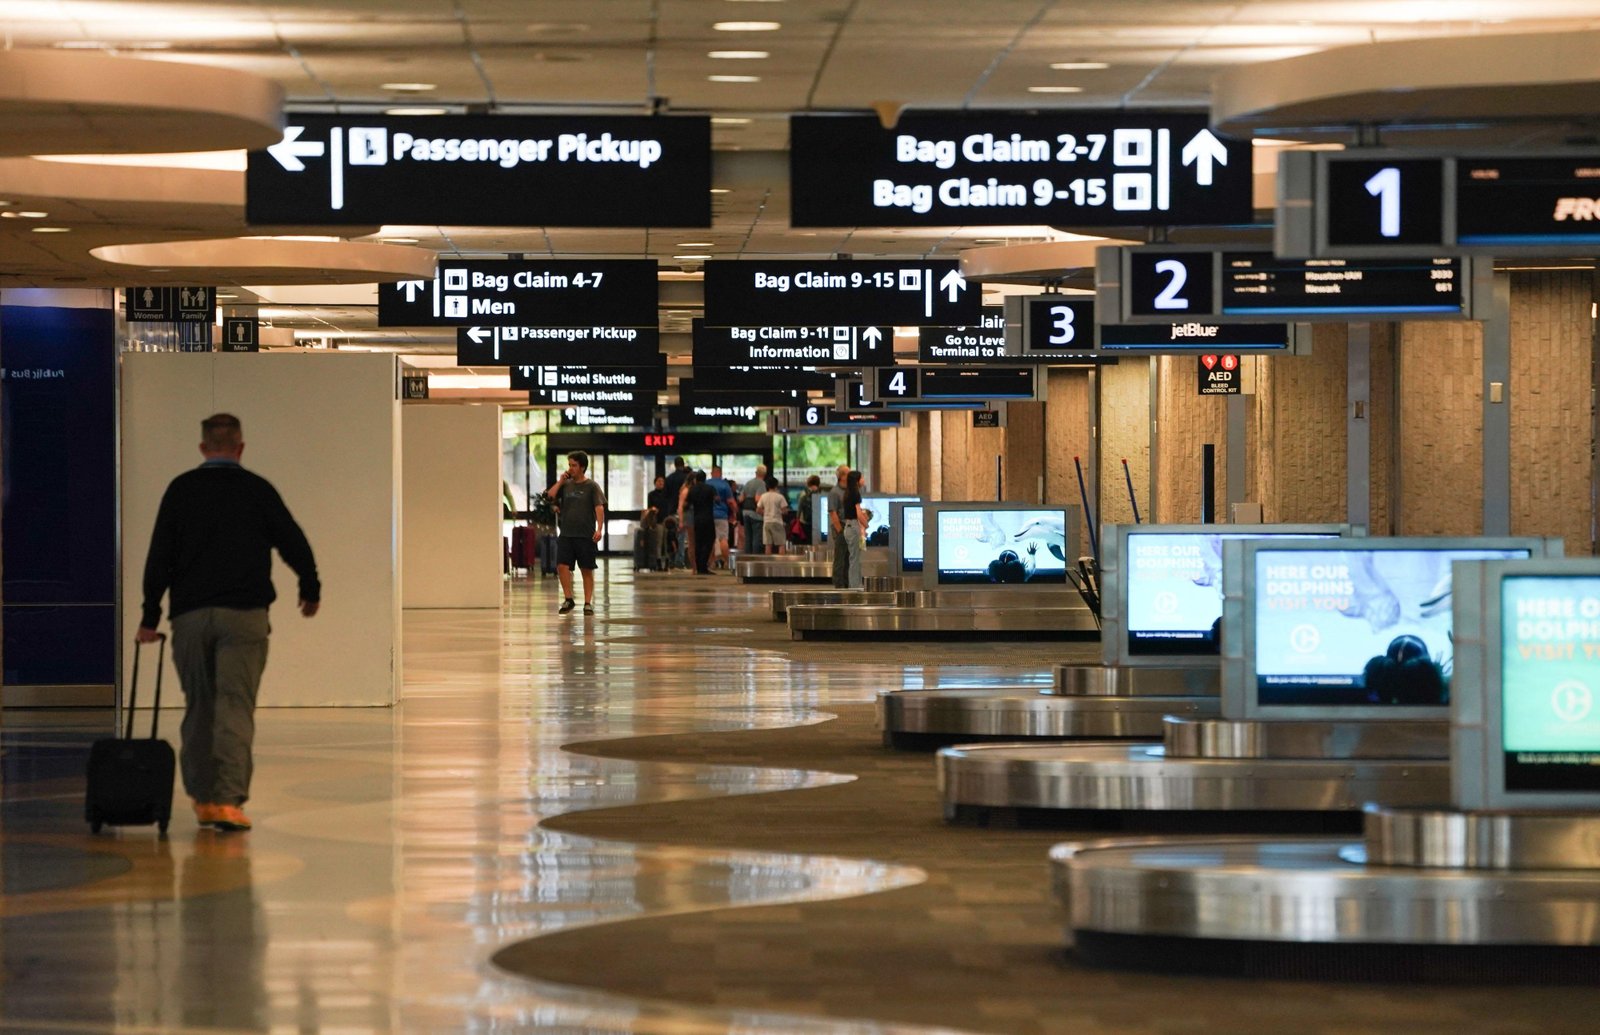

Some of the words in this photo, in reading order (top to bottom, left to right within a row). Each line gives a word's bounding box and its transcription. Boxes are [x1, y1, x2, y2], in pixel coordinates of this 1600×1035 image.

[392, 131, 553, 169] Passenger
[557, 131, 663, 170] Pickup
[896, 133, 956, 170] Bag
[961, 132, 1051, 163] Claim
[1056, 133, 1107, 163] 2-7
[873, 178, 933, 214] Bag
[938, 177, 1027, 207] Claim
[1032, 178, 1107, 207] 9-15
[1364, 167, 1401, 237] 1
[1553, 197, 1600, 221] FR
[471, 271, 509, 292] Bag
[513, 271, 568, 289] Claim
[571, 272, 604, 289] 4-7
[754, 271, 791, 293] Bag
[794, 271, 847, 289] Claim
[850, 271, 895, 289] 9-15
[1154, 259, 1189, 309] 2
[471, 298, 516, 315] Men
[134, 312, 164, 320] Women
[181, 312, 207, 321] Family
[978, 314, 1006, 329] lai
[1048, 305, 1076, 345] 3
[1170, 323, 1218, 340] jetBlue
[521, 327, 589, 342] Passenger
[592, 327, 637, 343] Pickup
[731, 327, 757, 342] Bag
[759, 326, 798, 340] Claim
[800, 326, 830, 340] 9-11
[945, 334, 962, 346] Go
[963, 336, 977, 346] to
[749, 344, 830, 359] Information
[930, 345, 979, 358] Terminal
[981, 347, 995, 357] to
[561, 373, 590, 385] Hotel
[592, 373, 637, 385] Shuttles
[888, 371, 907, 395] 4
[1208, 371, 1232, 382] AED
[570, 391, 595, 402] Hotel
[596, 390, 634, 402] Shuttles
[806, 406, 818, 425] 6
[645, 434, 676, 447] EXIT
[1266, 565, 1309, 579] HERE
[1311, 565, 1350, 579] OUR
[1266, 581, 1355, 596] DOLPHINS
[1517, 598, 1576, 617] HERE
